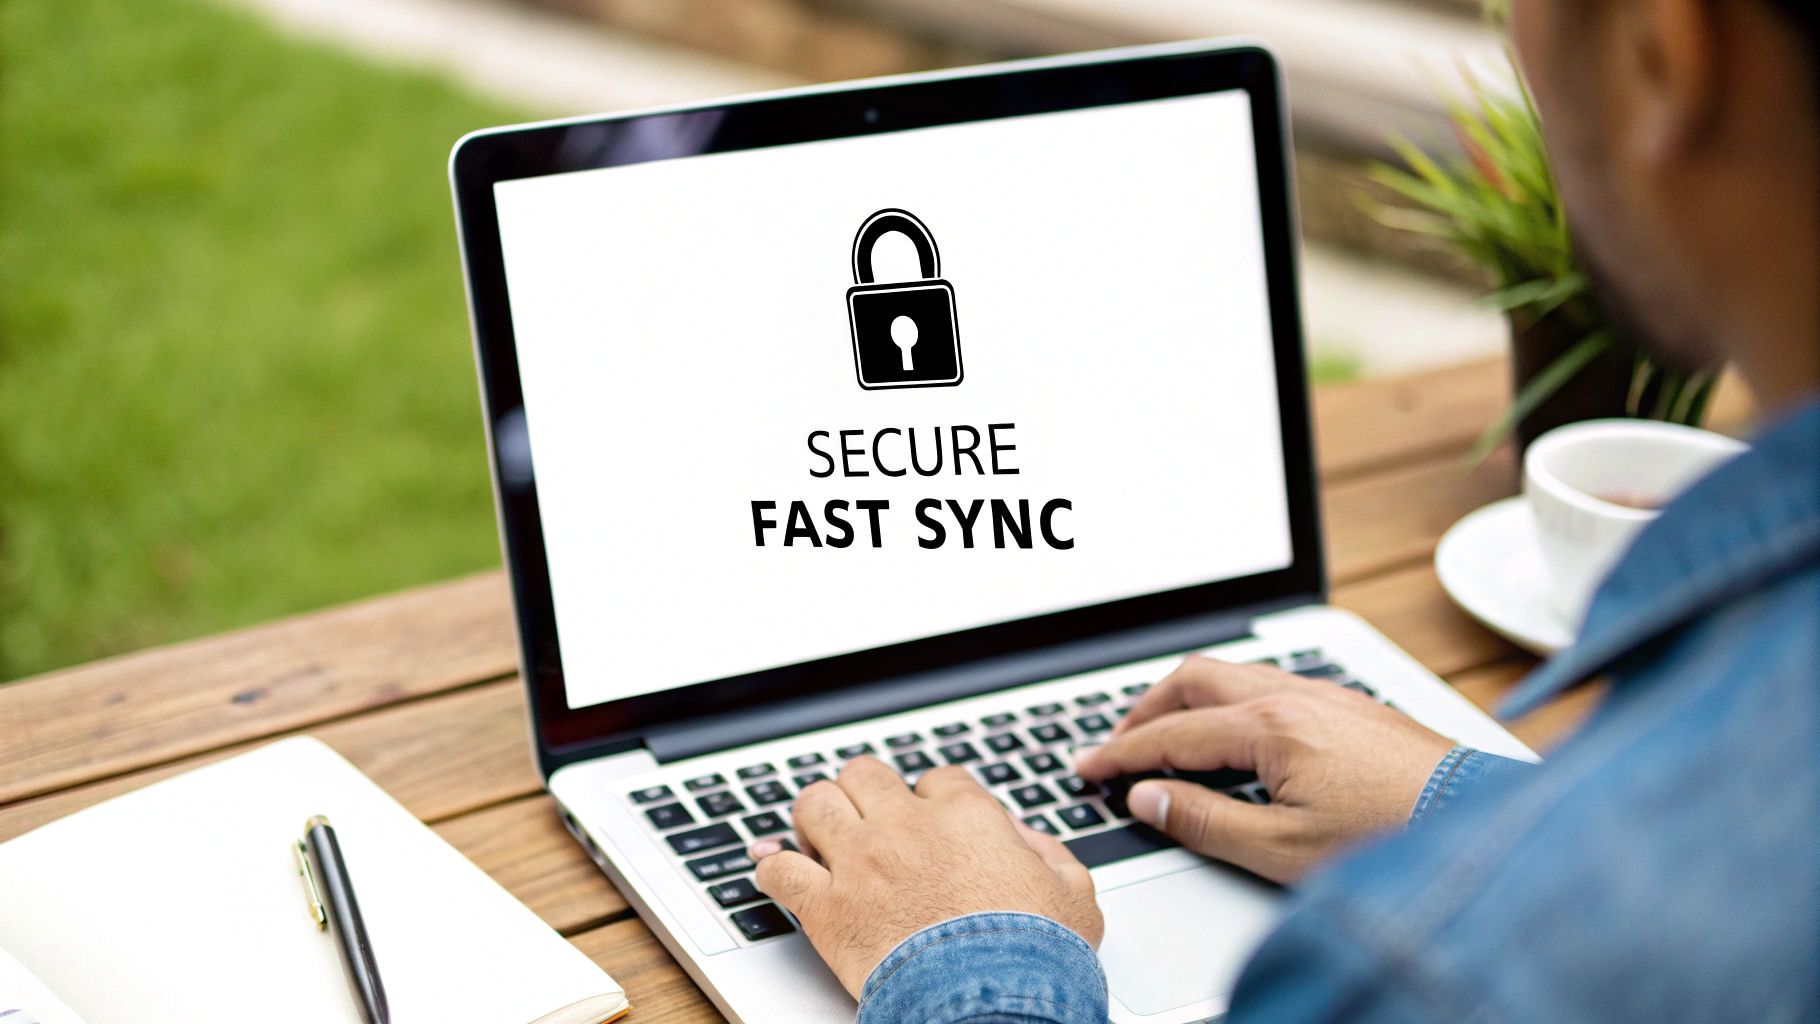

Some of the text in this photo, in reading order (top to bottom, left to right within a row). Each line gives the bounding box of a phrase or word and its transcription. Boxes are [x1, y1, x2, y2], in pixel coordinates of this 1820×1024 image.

[807, 422, 1020, 478] SECURE
[750, 497, 1075, 550] FAST SYNC
